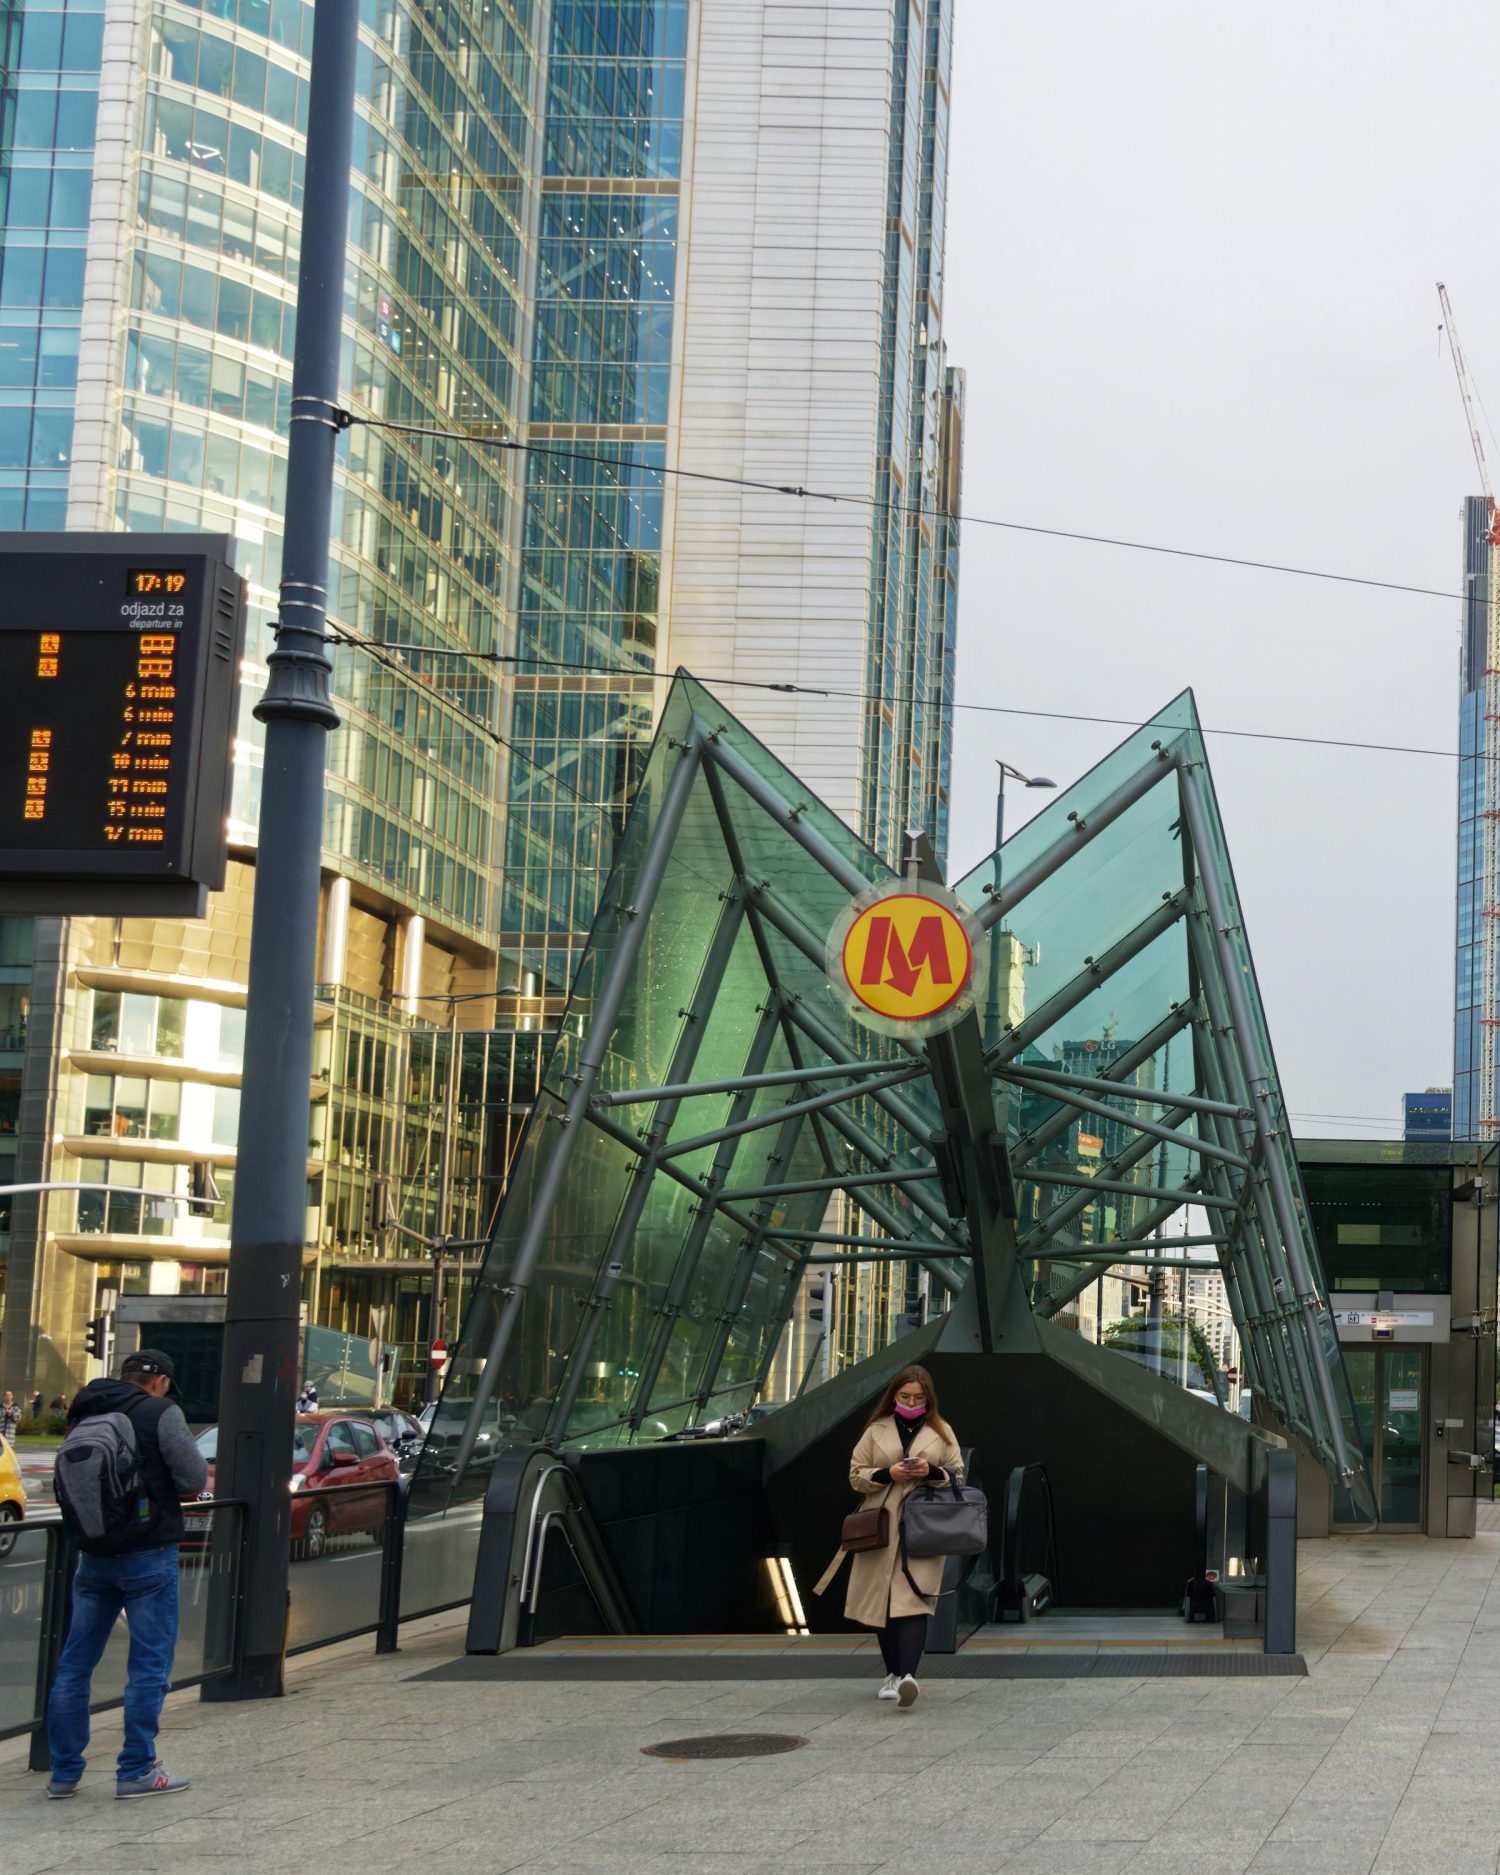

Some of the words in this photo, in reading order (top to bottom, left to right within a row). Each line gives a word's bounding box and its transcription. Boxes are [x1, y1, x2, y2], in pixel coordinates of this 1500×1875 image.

[136, 575, 185, 592] 17:19
[121, 602, 165, 619] odjazd
[168, 605, 184, 616] za
[129, 619, 173, 631] departure
[174, 619, 183, 629] in
[1101, 1041, 1116, 1050] LG
